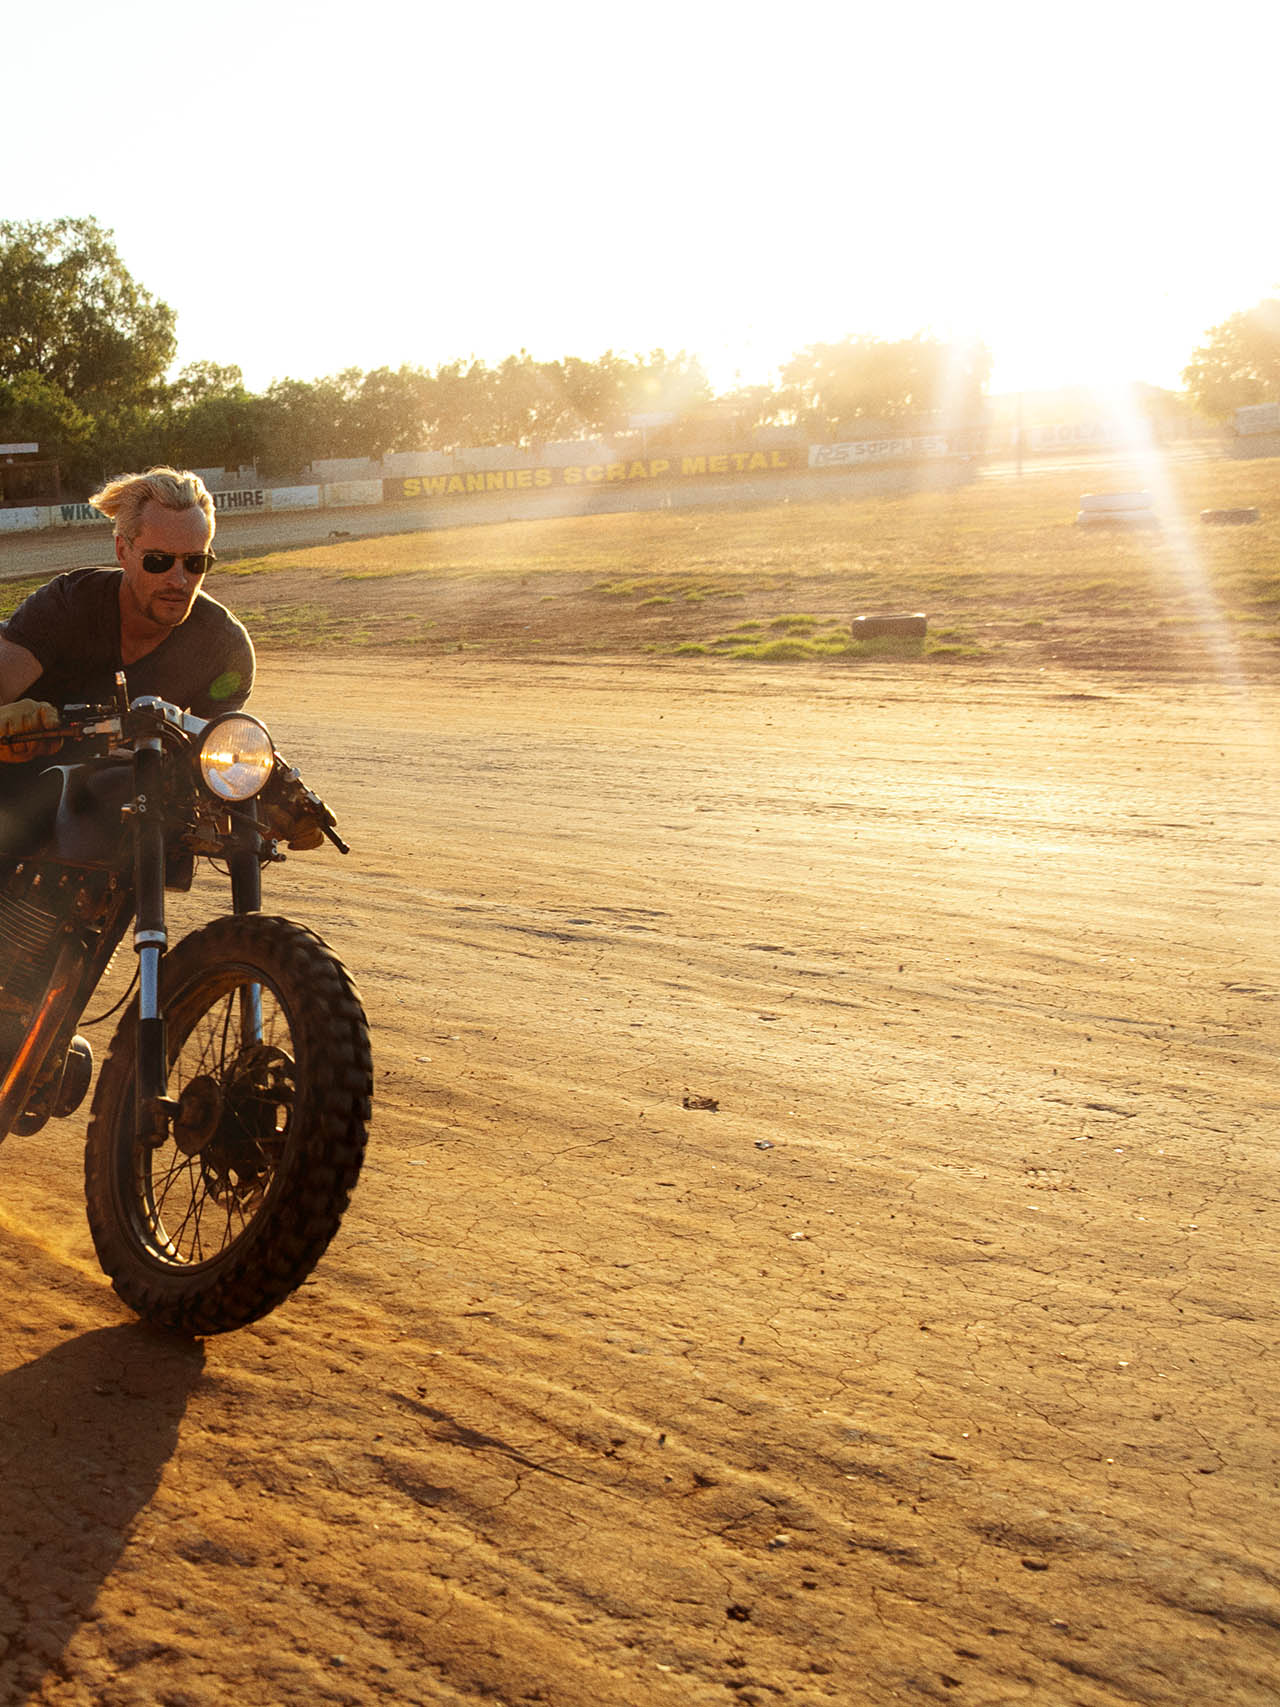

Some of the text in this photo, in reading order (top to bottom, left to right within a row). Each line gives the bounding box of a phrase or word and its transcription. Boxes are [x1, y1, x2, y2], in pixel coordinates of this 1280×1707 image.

[402, 450, 788, 498] SWANNIES SCRAP METAL
